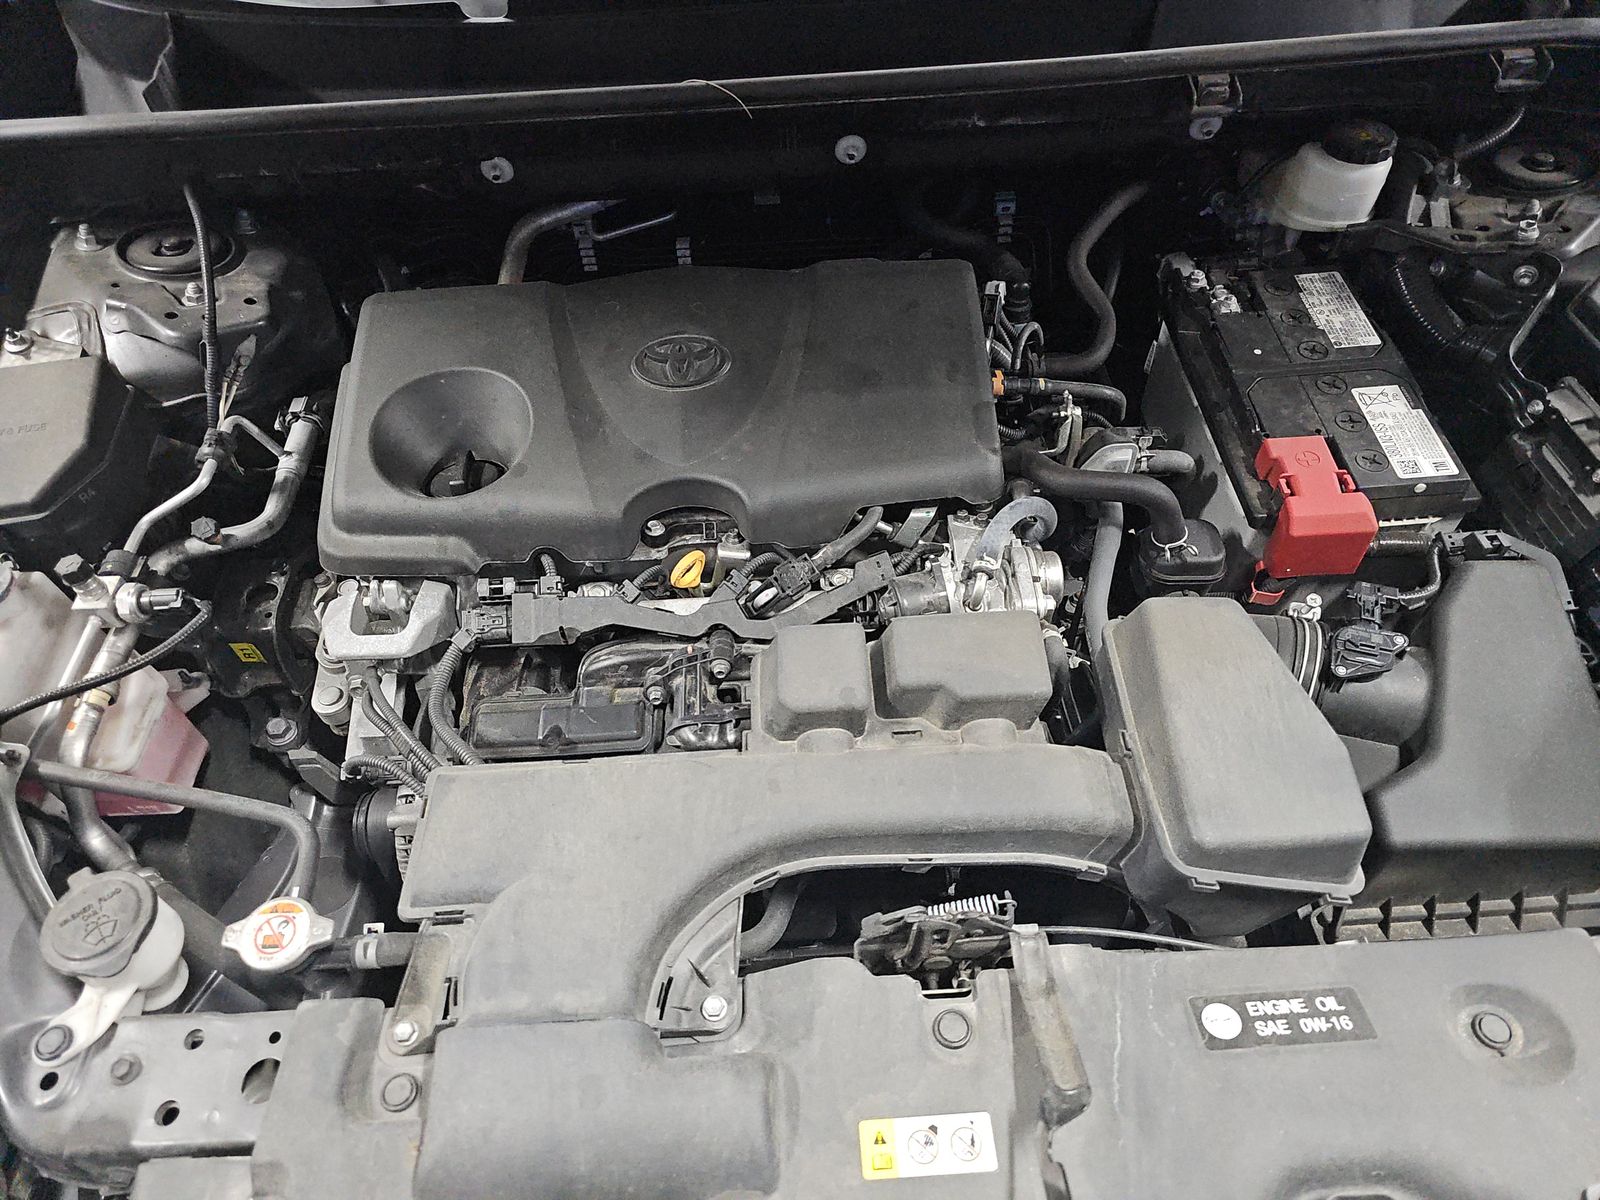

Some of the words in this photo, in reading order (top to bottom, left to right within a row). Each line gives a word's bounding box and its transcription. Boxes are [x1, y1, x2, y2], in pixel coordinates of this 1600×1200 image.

[1245, 998, 1309, 1017] ENGINE
[1314, 996, 1346, 1012] OIL
[1254, 1019, 1292, 1037] SAE
[1299, 1015, 1354, 1034] 0W-16
